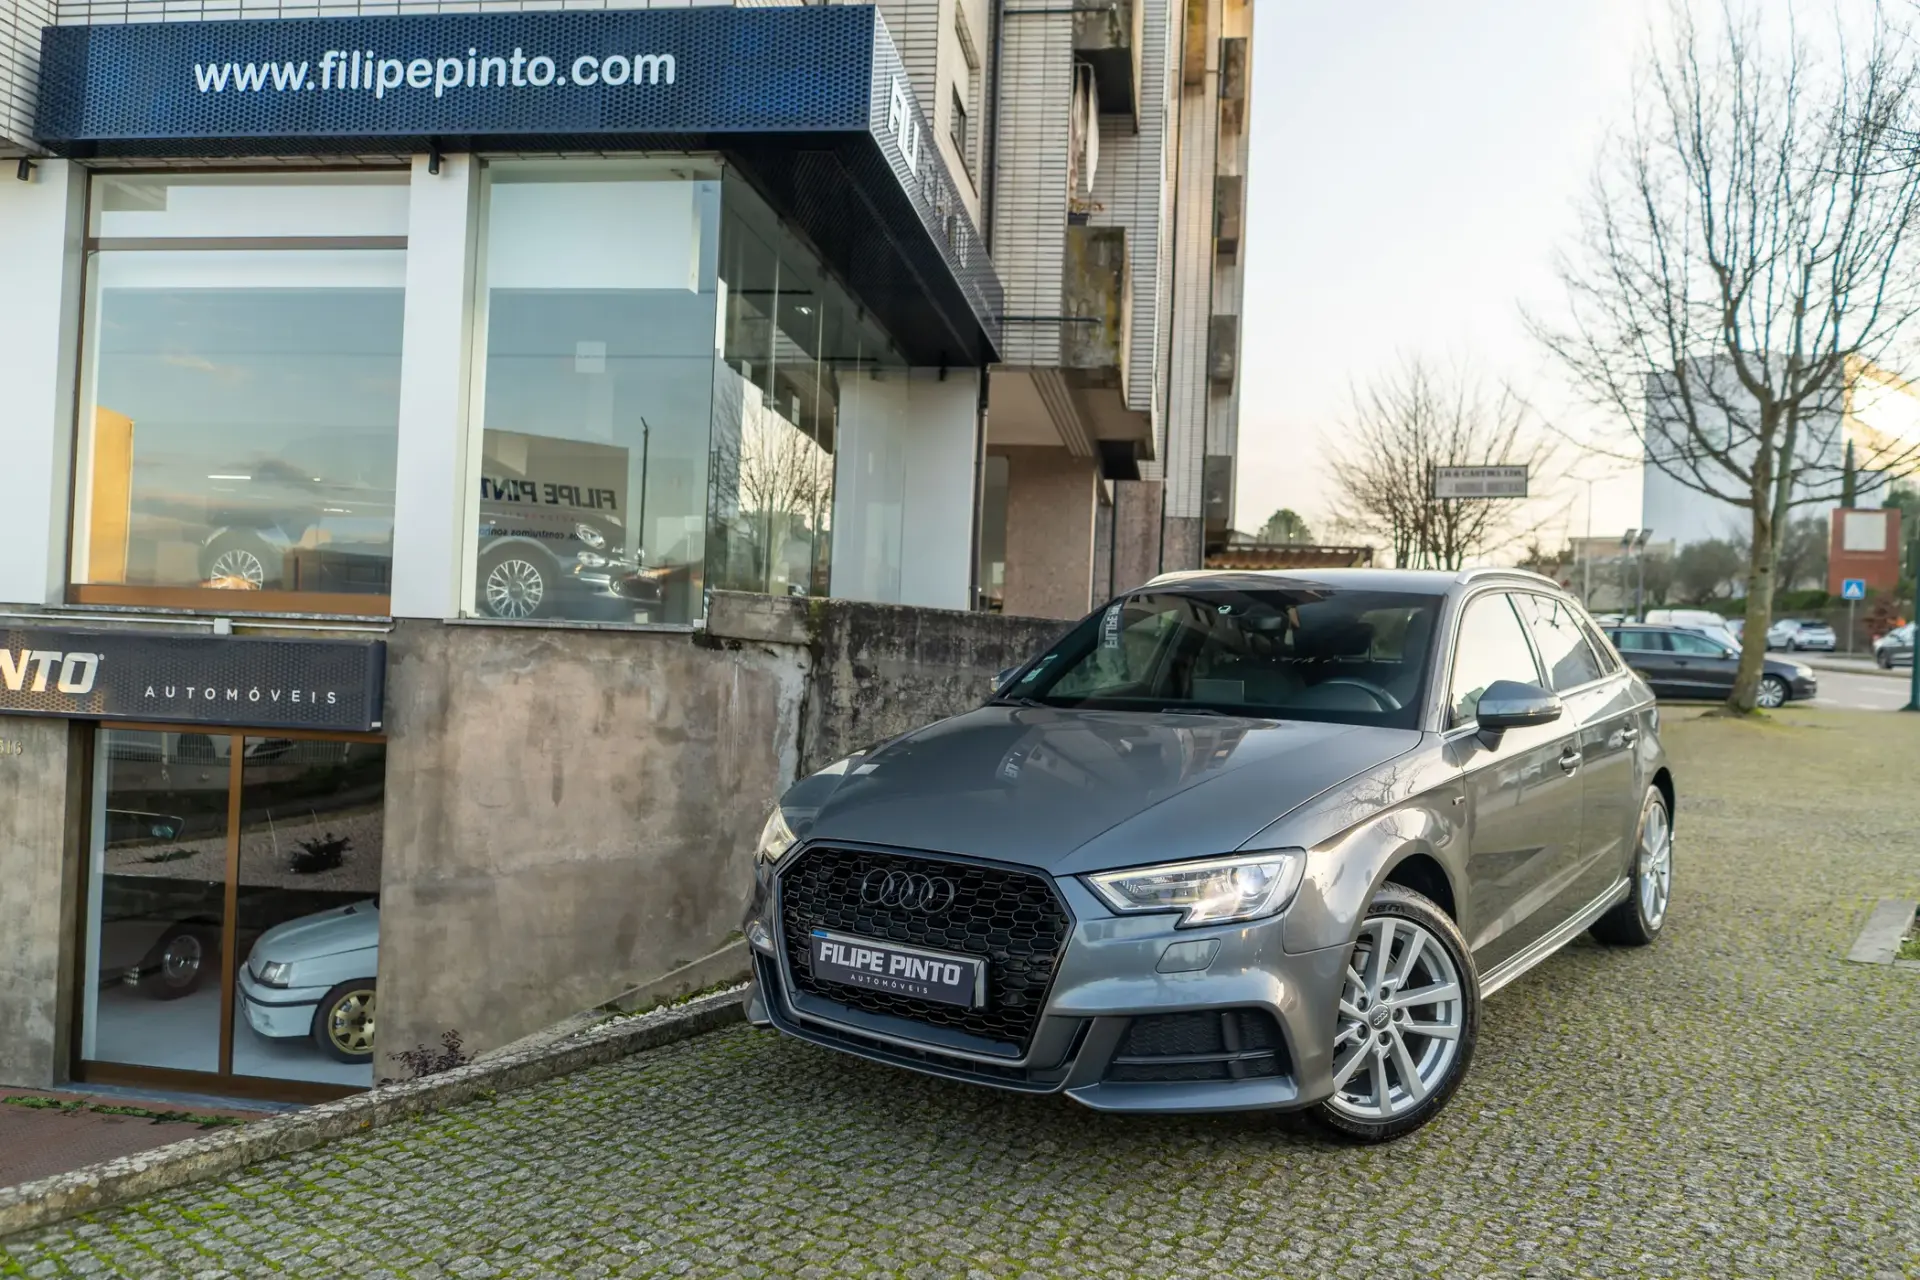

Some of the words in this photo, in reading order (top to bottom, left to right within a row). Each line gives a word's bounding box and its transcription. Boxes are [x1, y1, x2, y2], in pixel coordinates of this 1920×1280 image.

[194, 46, 676, 99] www.filipepinto.com
[144, 685, 337, 705] AUTOMÓVEIS
[819, 942, 885, 973] FILIPE
[889, 954, 961, 986] PINTO
[851, 974, 928, 994] AUTOMÓVEIS
